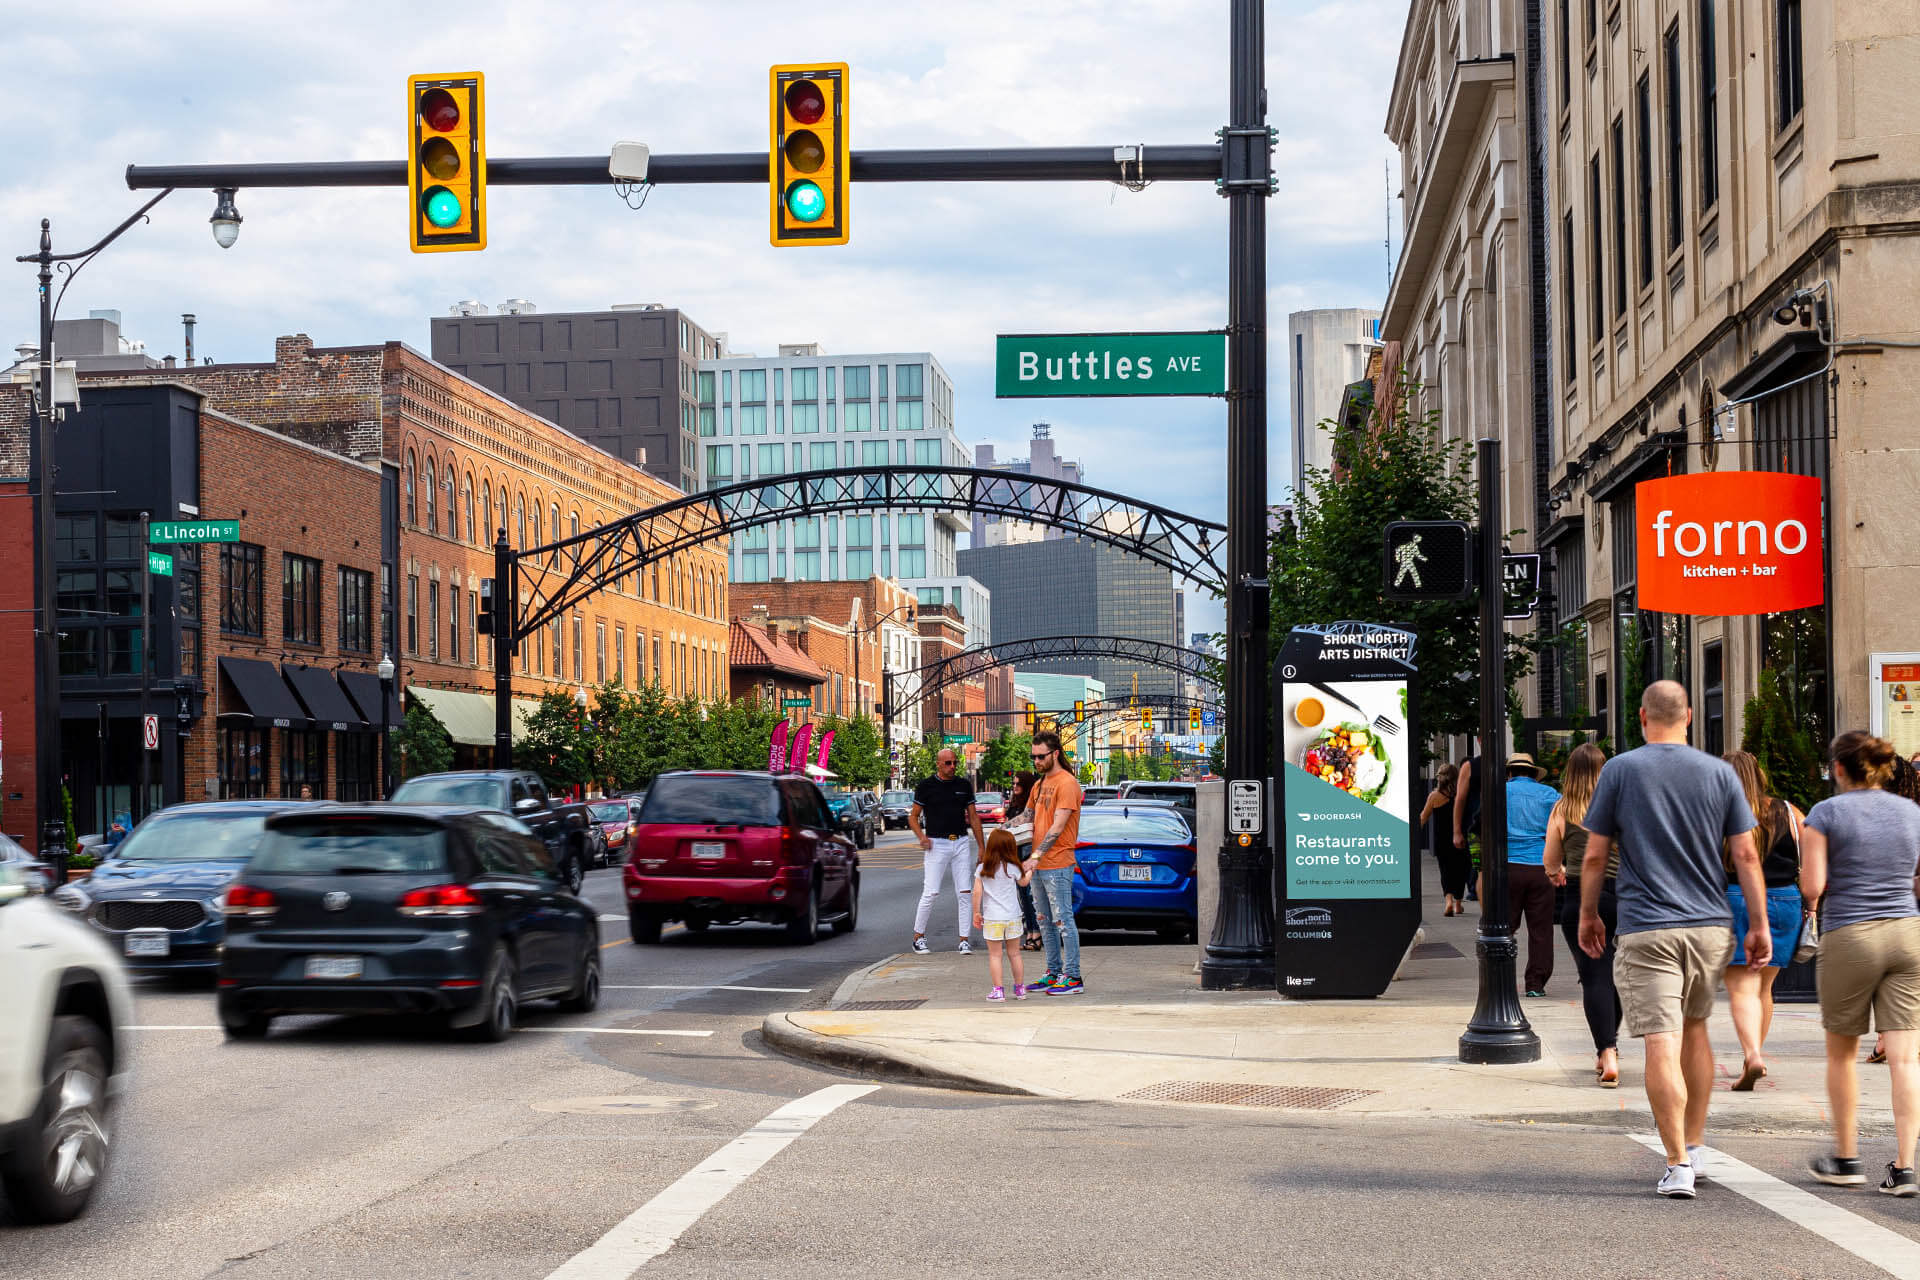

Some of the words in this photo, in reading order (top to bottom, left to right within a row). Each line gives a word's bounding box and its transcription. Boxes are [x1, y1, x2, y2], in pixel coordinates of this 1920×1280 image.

[1018, 351, 1153, 381] Buttles
[1166, 356, 1201, 372] AVE
[164, 525, 220, 539] Lincoln
[223, 527, 233, 535] ST
[1652, 510, 1808, 557] forno
[152, 556, 166, 574] High
[1683, 564, 1737, 578] kitchen
[1752, 563, 1777, 576] bar
[1323, 634, 1364, 645] SHORT
[1366, 633, 1408, 644] NORTH
[1318, 649, 1350, 660] ARTS
[1353, 648, 1408, 659] DISTRICT
[1313, 813, 1362, 821] DOORDASH
[1295, 834, 1392, 848] Restaurants
[1295, 855, 1340, 866] come
[1344, 852, 1361, 865] to
[1365, 854, 1399, 868] you.
[1286, 917, 1308, 925] short
[1307, 913, 1331, 921] north
[1286, 976, 1302, 985] ike
